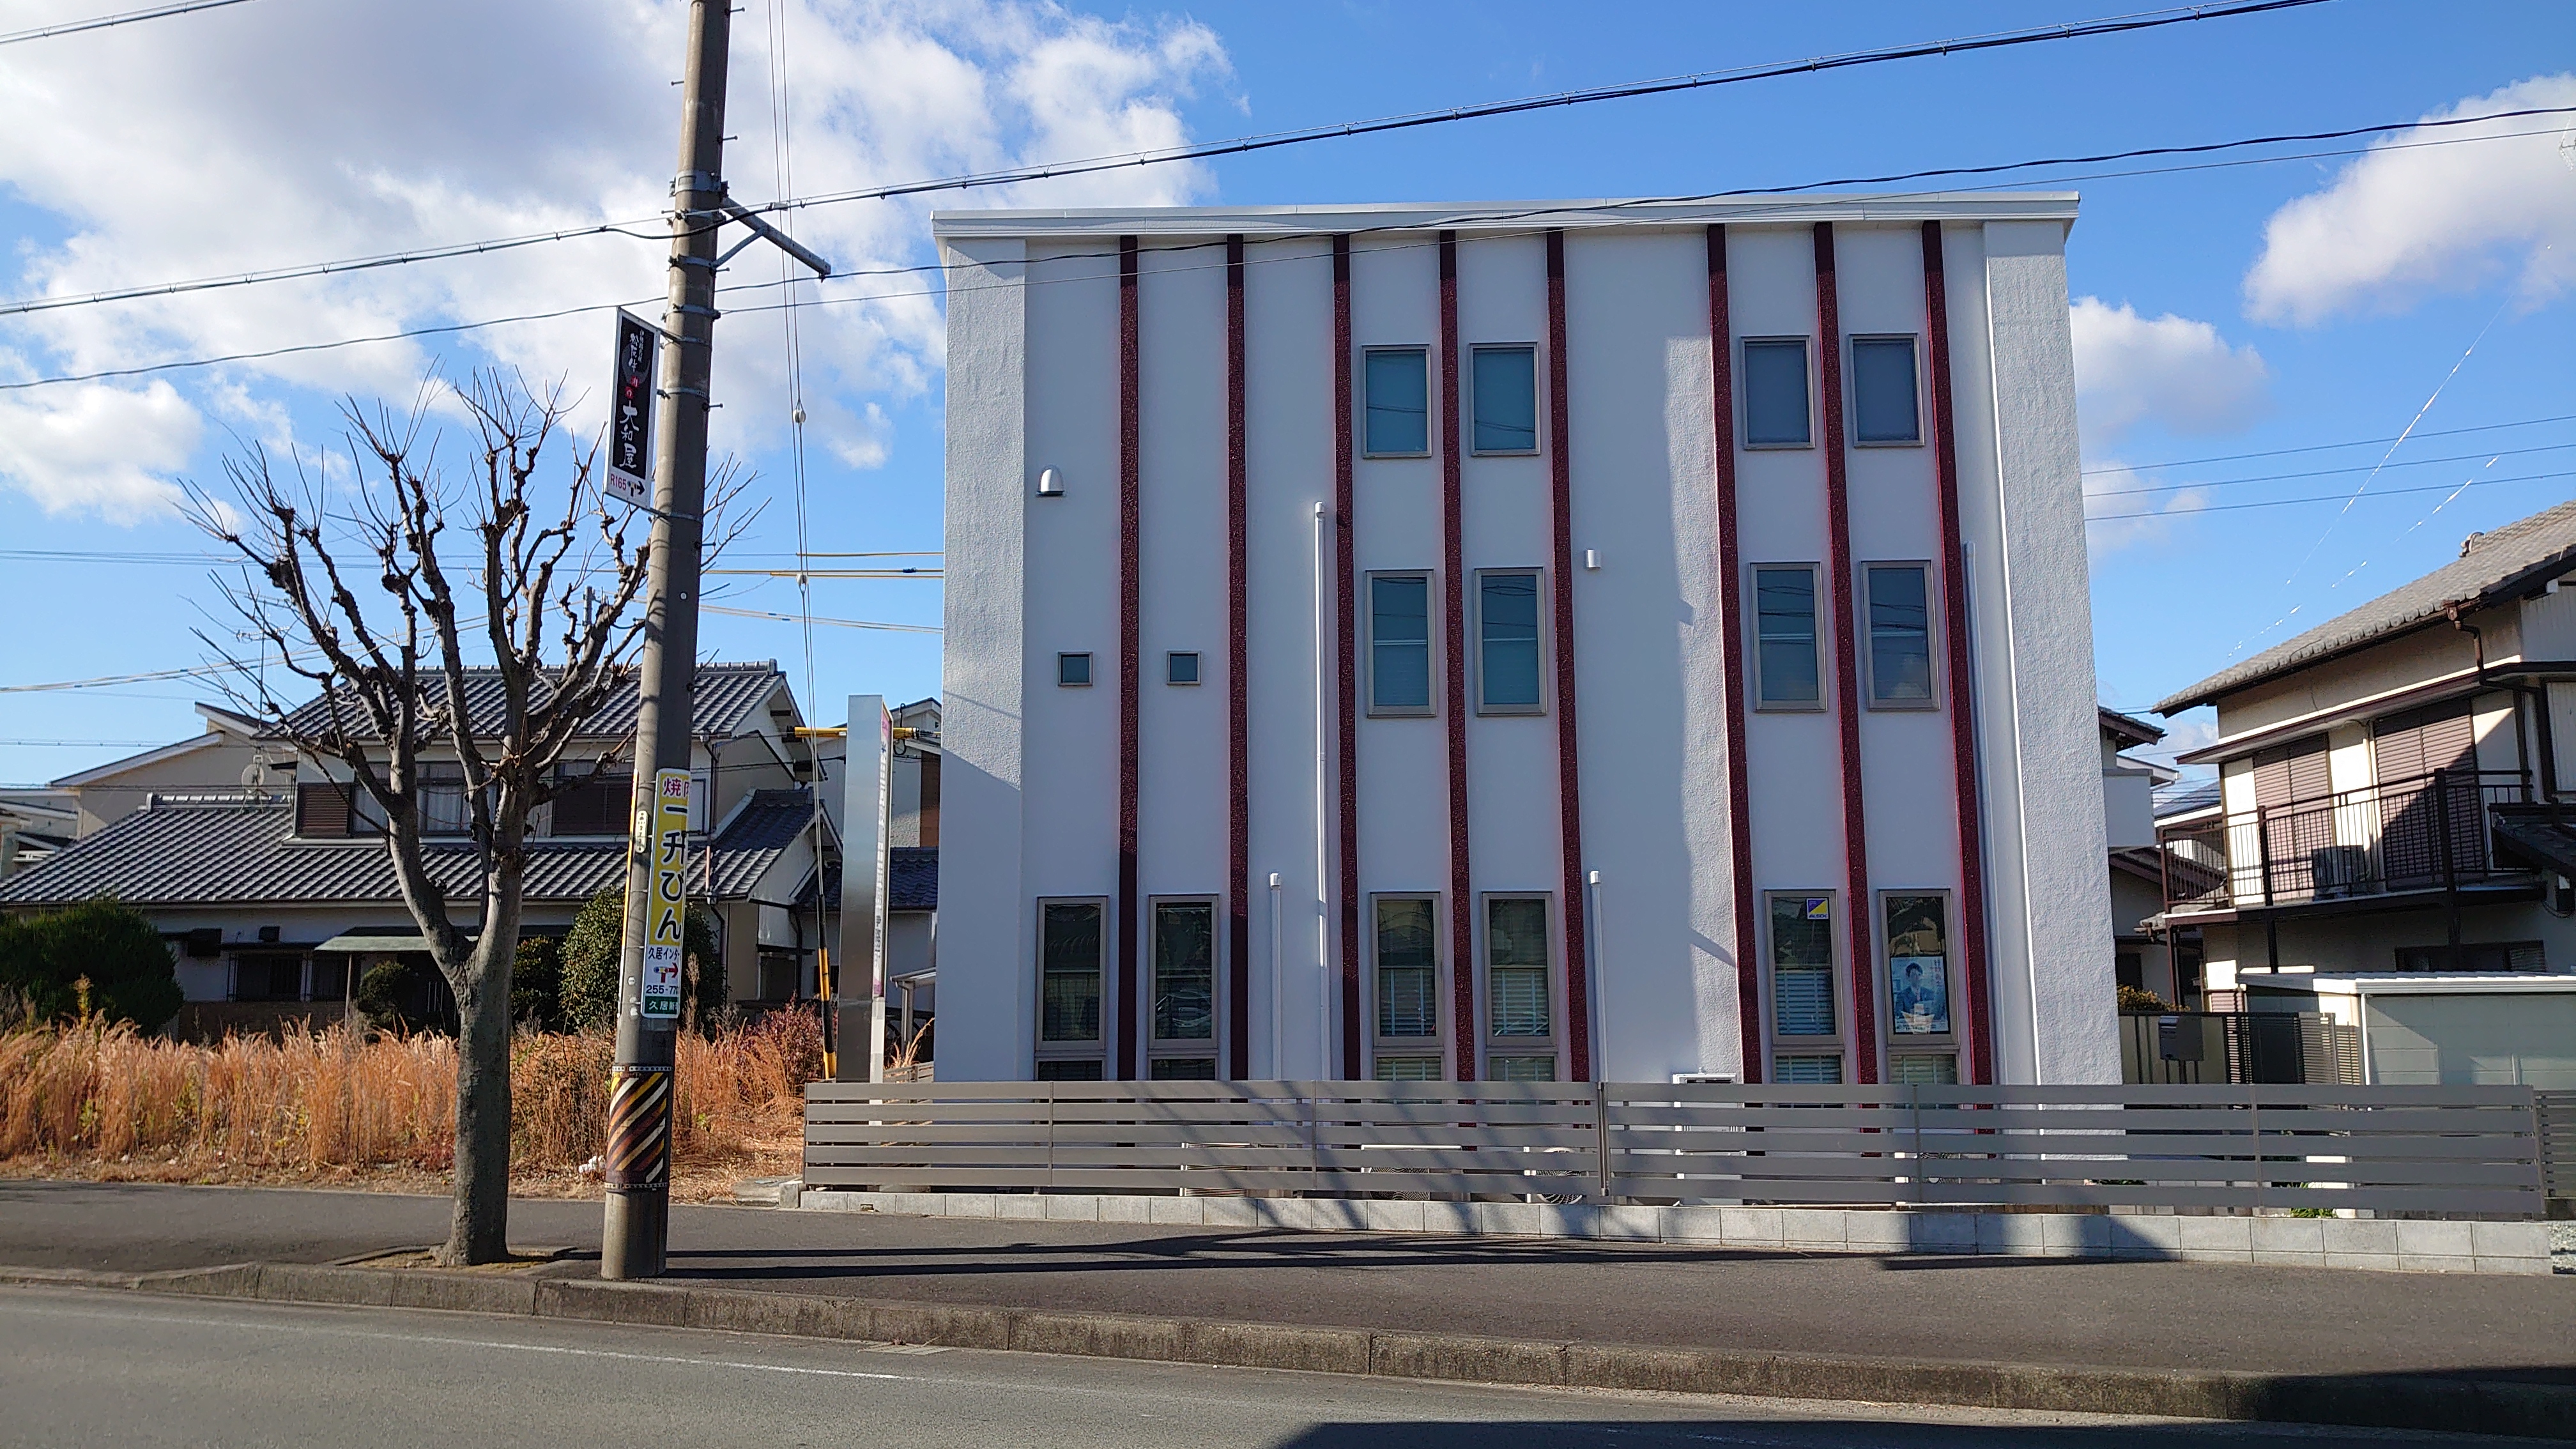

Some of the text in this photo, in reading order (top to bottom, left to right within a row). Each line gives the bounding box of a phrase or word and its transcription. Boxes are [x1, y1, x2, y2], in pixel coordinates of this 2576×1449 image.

[619, 399, 640, 468] 大和屋
[610, 473, 627, 491] R165
[657, 806, 688, 940] 一升びん
